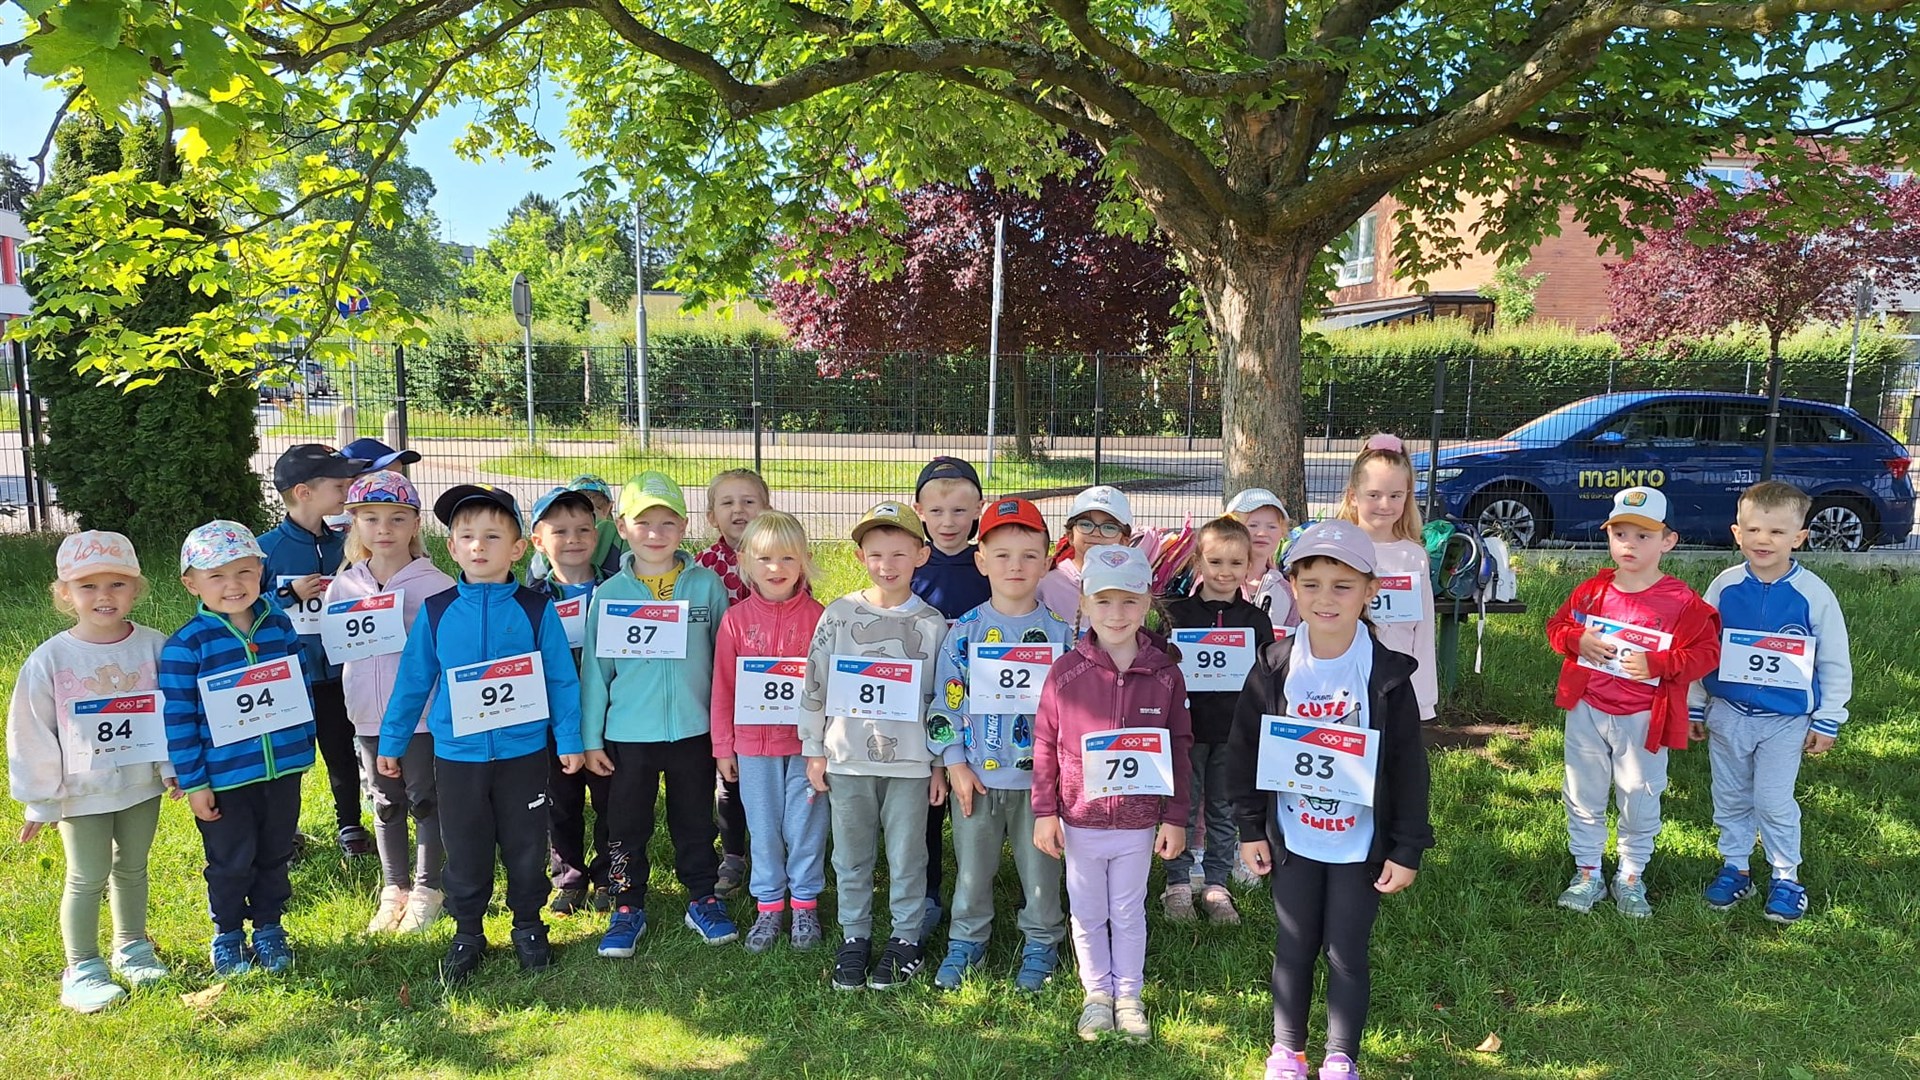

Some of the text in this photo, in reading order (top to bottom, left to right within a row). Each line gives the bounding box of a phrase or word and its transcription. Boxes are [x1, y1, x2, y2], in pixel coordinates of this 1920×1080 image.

[1579, 466, 1665, 488] makro
[73, 539, 123, 562] Love
[1371, 594, 1391, 610] 91
[346, 616, 375, 637] 96
[627, 625, 657, 644] 87
[1197, 651, 1226, 668] 98
[1749, 654, 1781, 673] 93
[999, 669, 1031, 688] 82
[236, 688, 275, 713] 94
[481, 683, 515, 706] 92
[764, 681, 794, 700] 88
[859, 684, 885, 704] 81
[1297, 701, 1346, 718] CUTE
[97, 719, 132, 742] 84
[1105, 757, 1139, 780] 79
[1295, 752, 1335, 780] 83
[1301, 813, 1355, 831] SWEET
